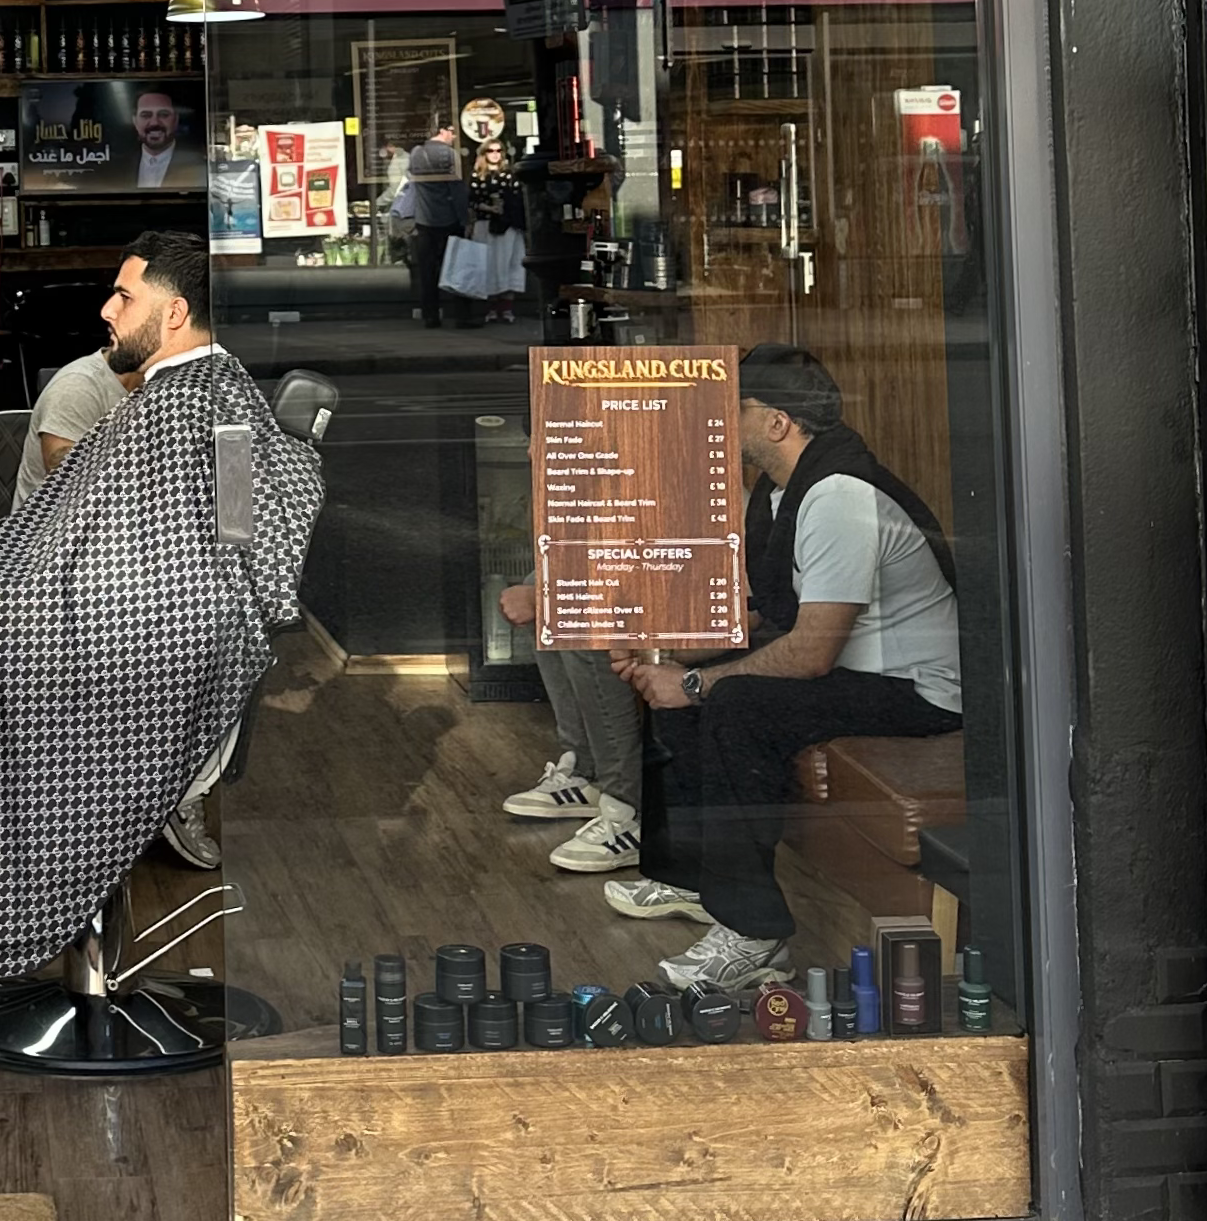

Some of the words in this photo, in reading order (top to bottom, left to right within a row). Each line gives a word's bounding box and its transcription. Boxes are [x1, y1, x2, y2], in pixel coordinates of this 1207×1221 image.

[60, 148, 73, 162] ما
[542, 359, 668, 385] KINGSLAND
[669, 359, 728, 381] CUTS
[601, 399, 640, 411] PRICE
[642, 399, 668, 410] LIST
[714, 435, 725, 443] 27
[546, 452, 557, 460] All
[558, 452, 576, 460] Over
[577, 451, 594, 459] One
[547, 468, 570, 476] Beard
[570, 468, 589, 476] Trim
[547, 484, 576, 492] Waxing
[547, 499, 577, 507] Normal
[577, 499, 605, 507] Haircut
[614, 499, 637, 507] Beard
[638, 498, 657, 507] Trim
[593, 515, 616, 523] Beard
[617, 514, 636, 523] Trim
[587, 548, 640, 560] SPECIAL
[642, 548, 693, 559] OFFERS
[596, 562, 634, 573] Monday
[641, 562, 685, 573] Thursday
[588, 579, 604, 587] Hair
[605, 579, 620, 587] Cut
[716, 578, 728, 586] 20
[716, 592, 728, 600] 20
[556, 607, 582, 615] Senior
[613, 606, 633, 615] Over
[717, 606, 728, 614] 20
[557, 620, 590, 629] Children
[591, 620, 615, 628] Under
[717, 620, 729, 628] 20
